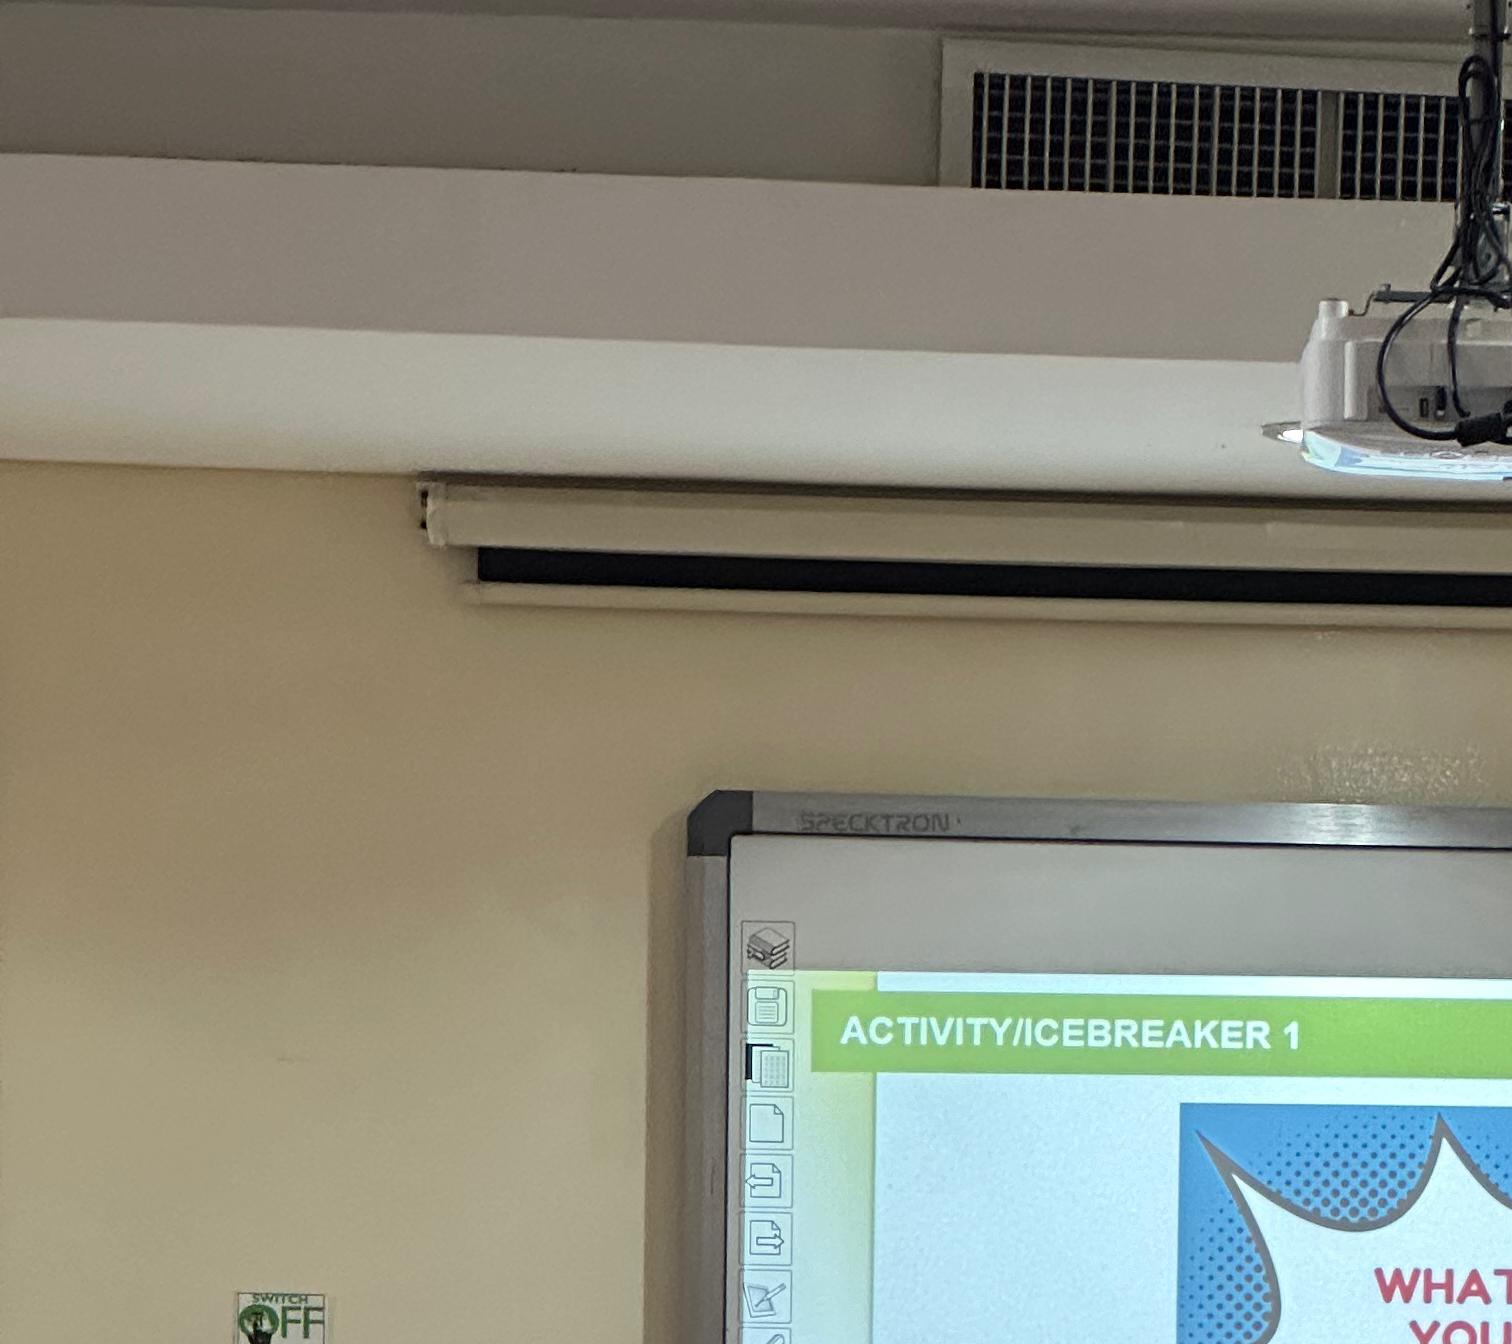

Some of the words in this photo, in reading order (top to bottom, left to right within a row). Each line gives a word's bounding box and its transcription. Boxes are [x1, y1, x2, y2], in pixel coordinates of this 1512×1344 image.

[800, 812, 950, 833] SPECKTRON
[839, 1015, 1272, 1051] ACTIVITY/ICEBREAKER
[1283, 1020, 1300, 1051] 1
[252, 1293, 309, 1305] SWITCH
